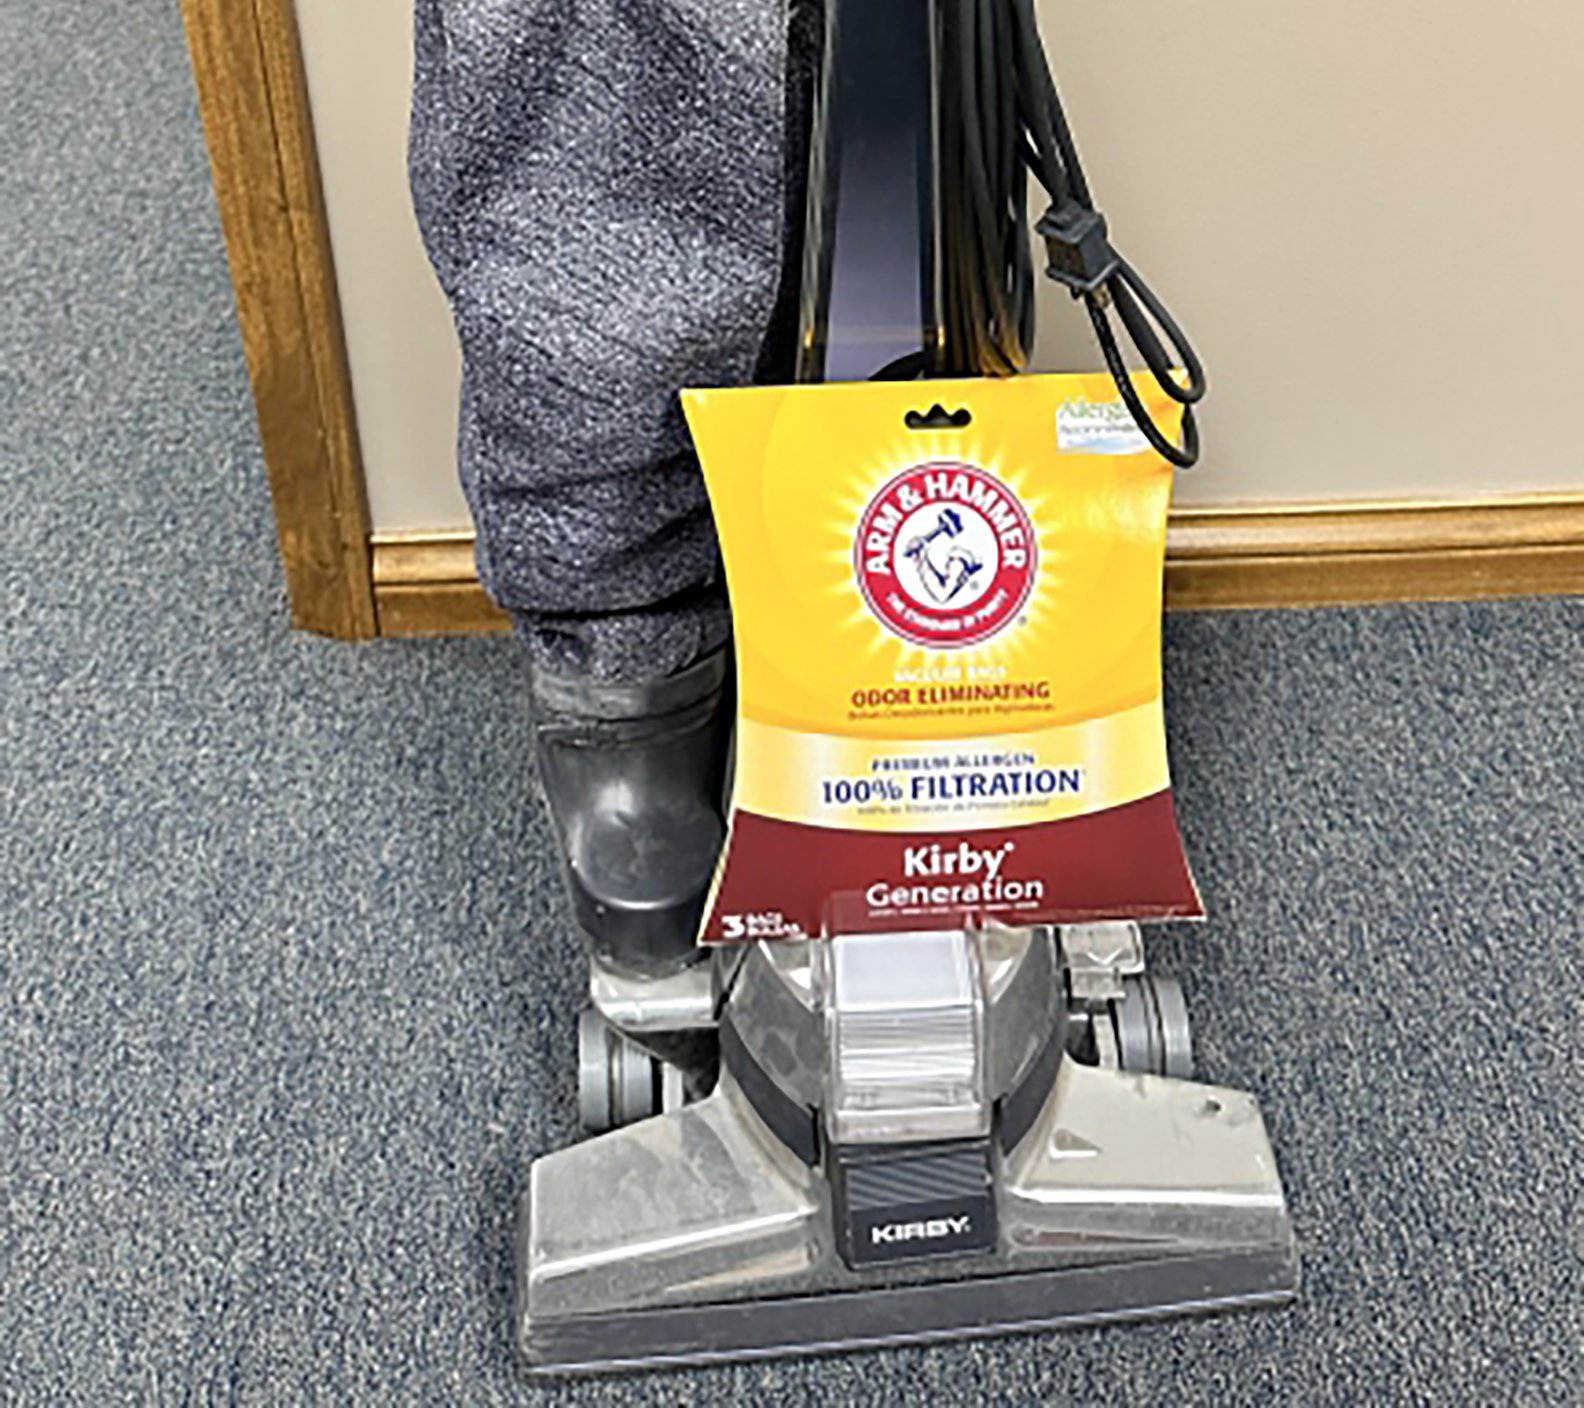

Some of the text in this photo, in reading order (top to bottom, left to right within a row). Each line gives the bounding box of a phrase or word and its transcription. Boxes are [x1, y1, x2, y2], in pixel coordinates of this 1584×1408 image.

[866, 472, 1027, 575] ARM & HAMMER
[851, 681, 1050, 708] ODOR ELIMINATING
[822, 769, 1081, 804] 100% FILTRATION
[904, 842, 1005, 881] Kirby
[866, 876, 1043, 907] Generation
[722, 914, 745, 938] 3
[871, 1215, 970, 1244] KIRBY
